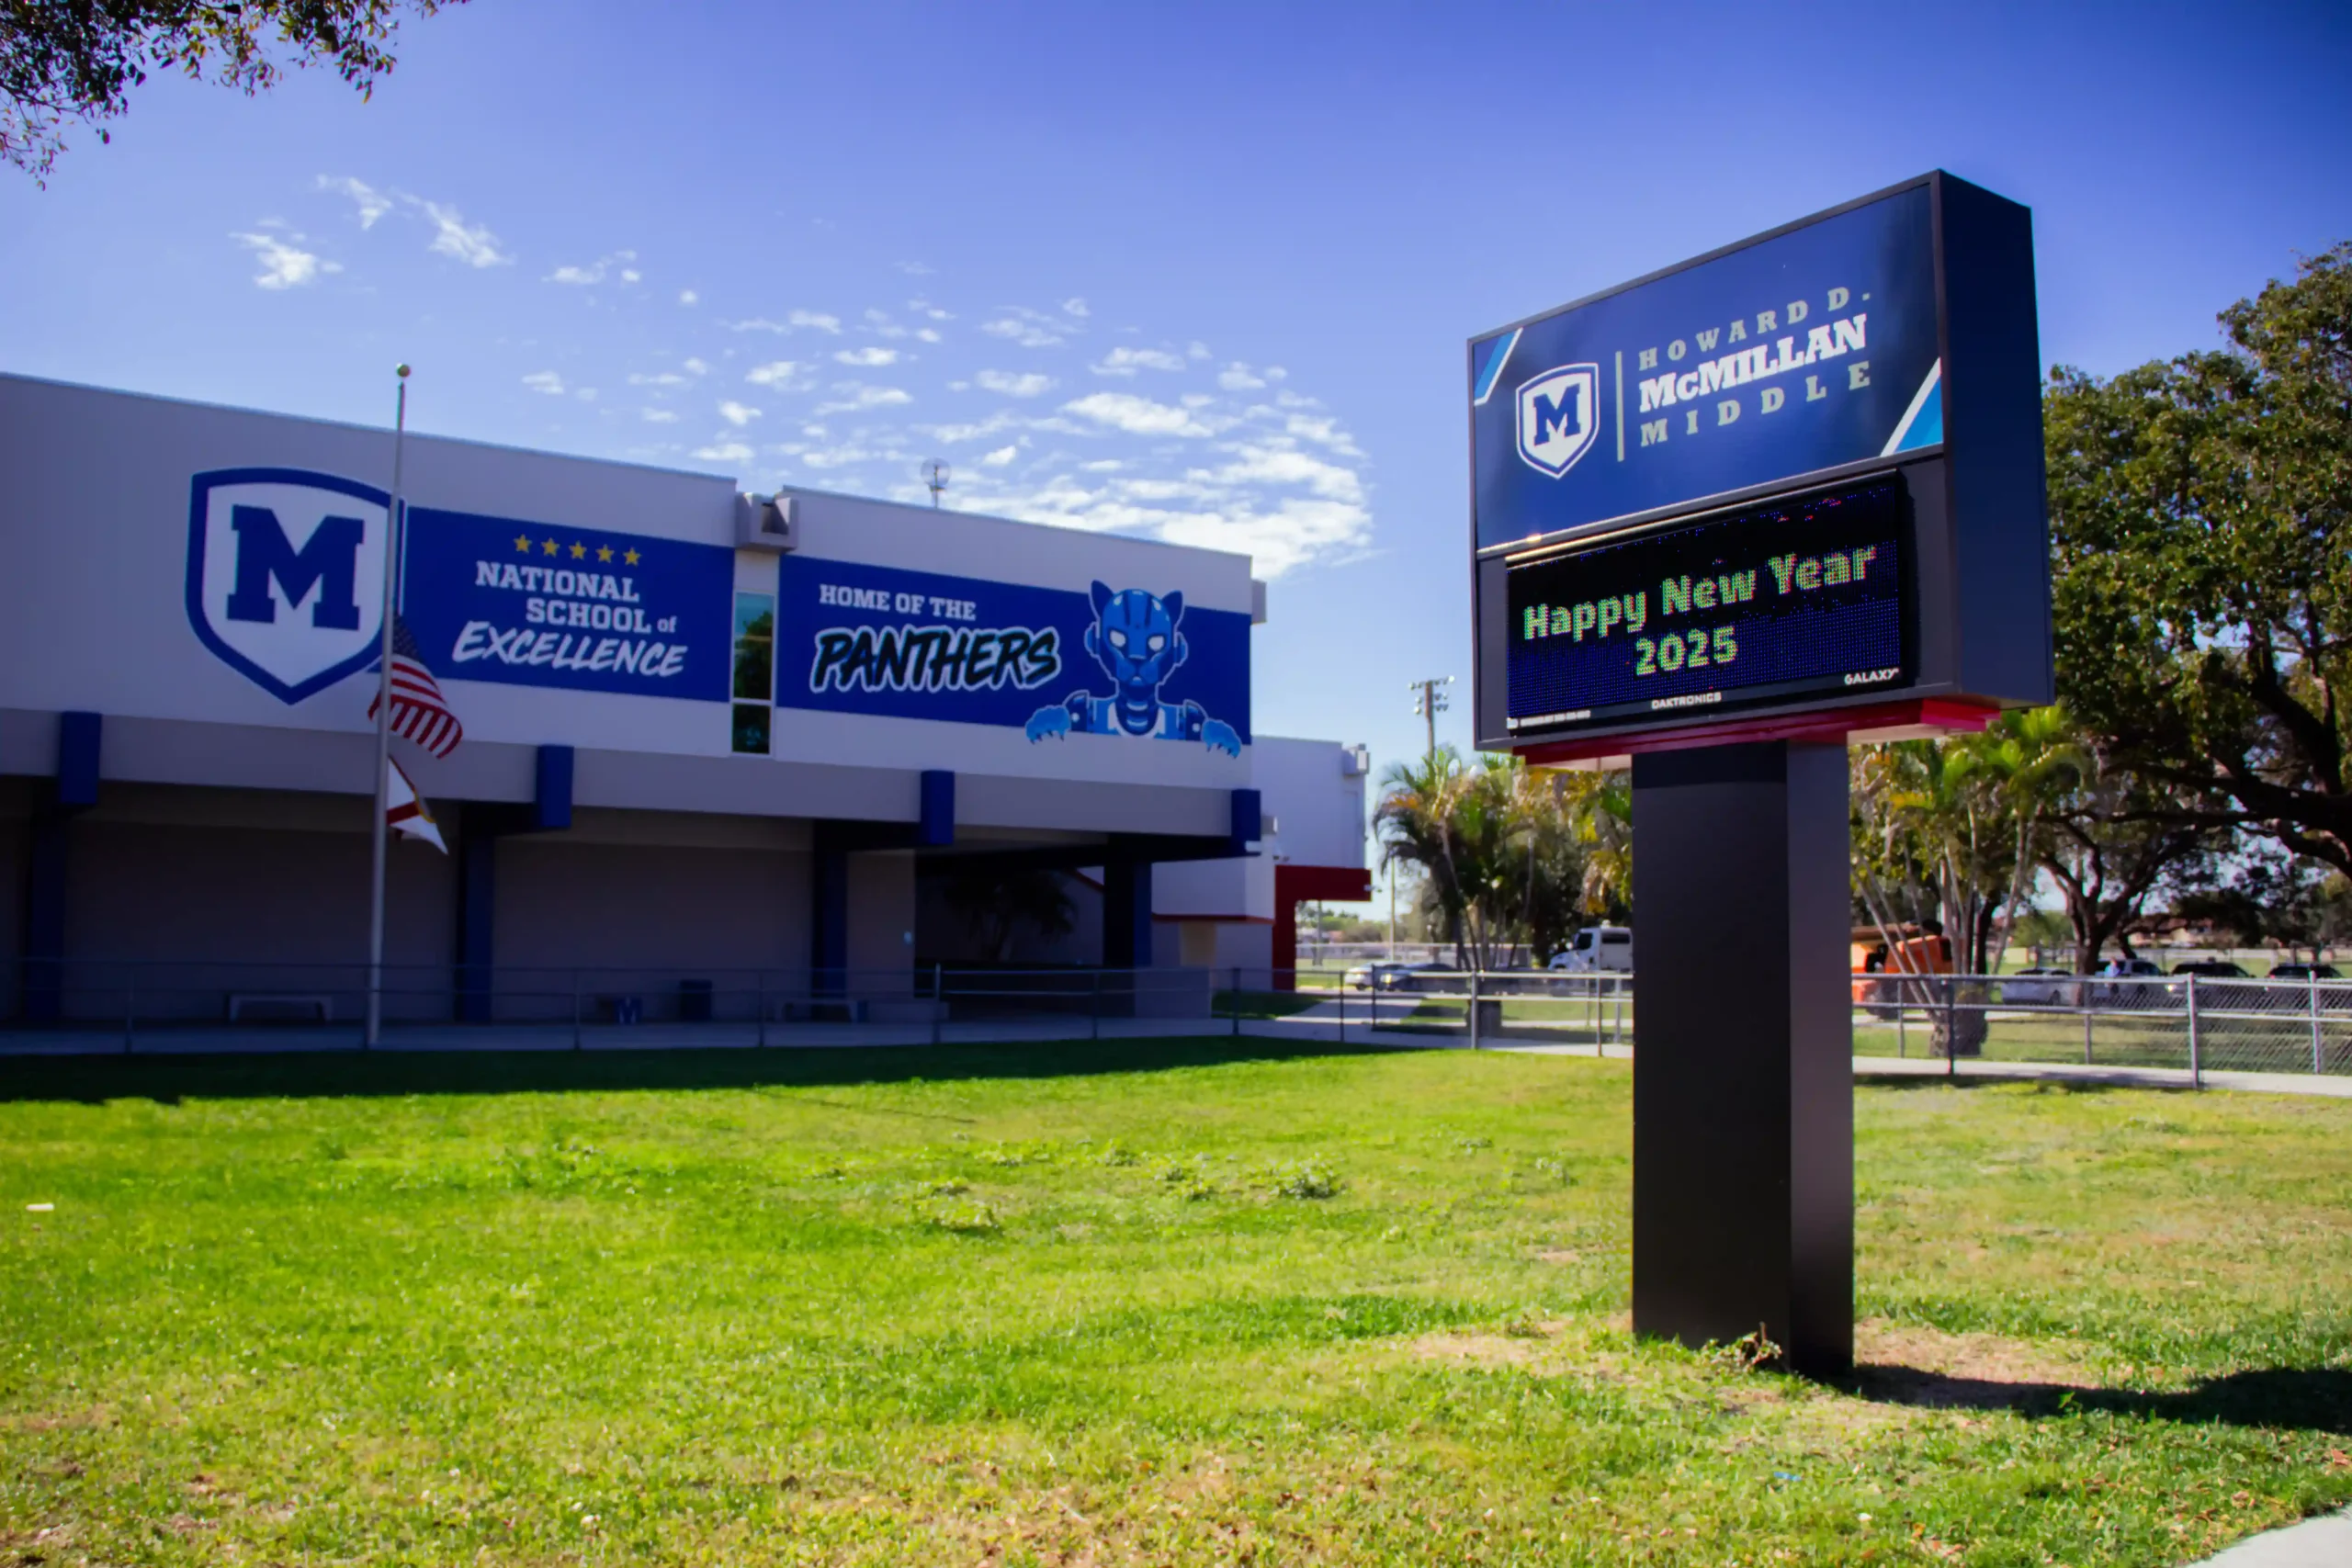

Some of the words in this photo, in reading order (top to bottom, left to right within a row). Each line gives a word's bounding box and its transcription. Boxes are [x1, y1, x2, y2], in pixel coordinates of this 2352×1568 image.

[1638, 299, 1808, 371] HOWARD
[1827, 286, 1871, 312] D.
[1638, 312, 1868, 413] McMILLAN
[1532, 382, 1582, 448] M
[1639, 362, 1871, 447] MIDDLE
[226, 503, 365, 632] M
[474, 559, 640, 604] NATIONAL
[1523, 591, 1647, 642] Happy
[1661, 569, 1758, 615] New
[1768, 545, 1877, 595] Year
[525, 596, 652, 635] SCHOOL
[656, 615, 678, 634] of
[819, 582, 891, 613] HOME
[894, 592, 925, 615] OF
[928, 596, 978, 622] THE
[451, 619, 688, 678] EXCELLENCE
[809, 623, 1062, 694] PANTHERS
[1635, 625, 1739, 676] 2025
[1651, 692, 1723, 710] DAKTRONICS
